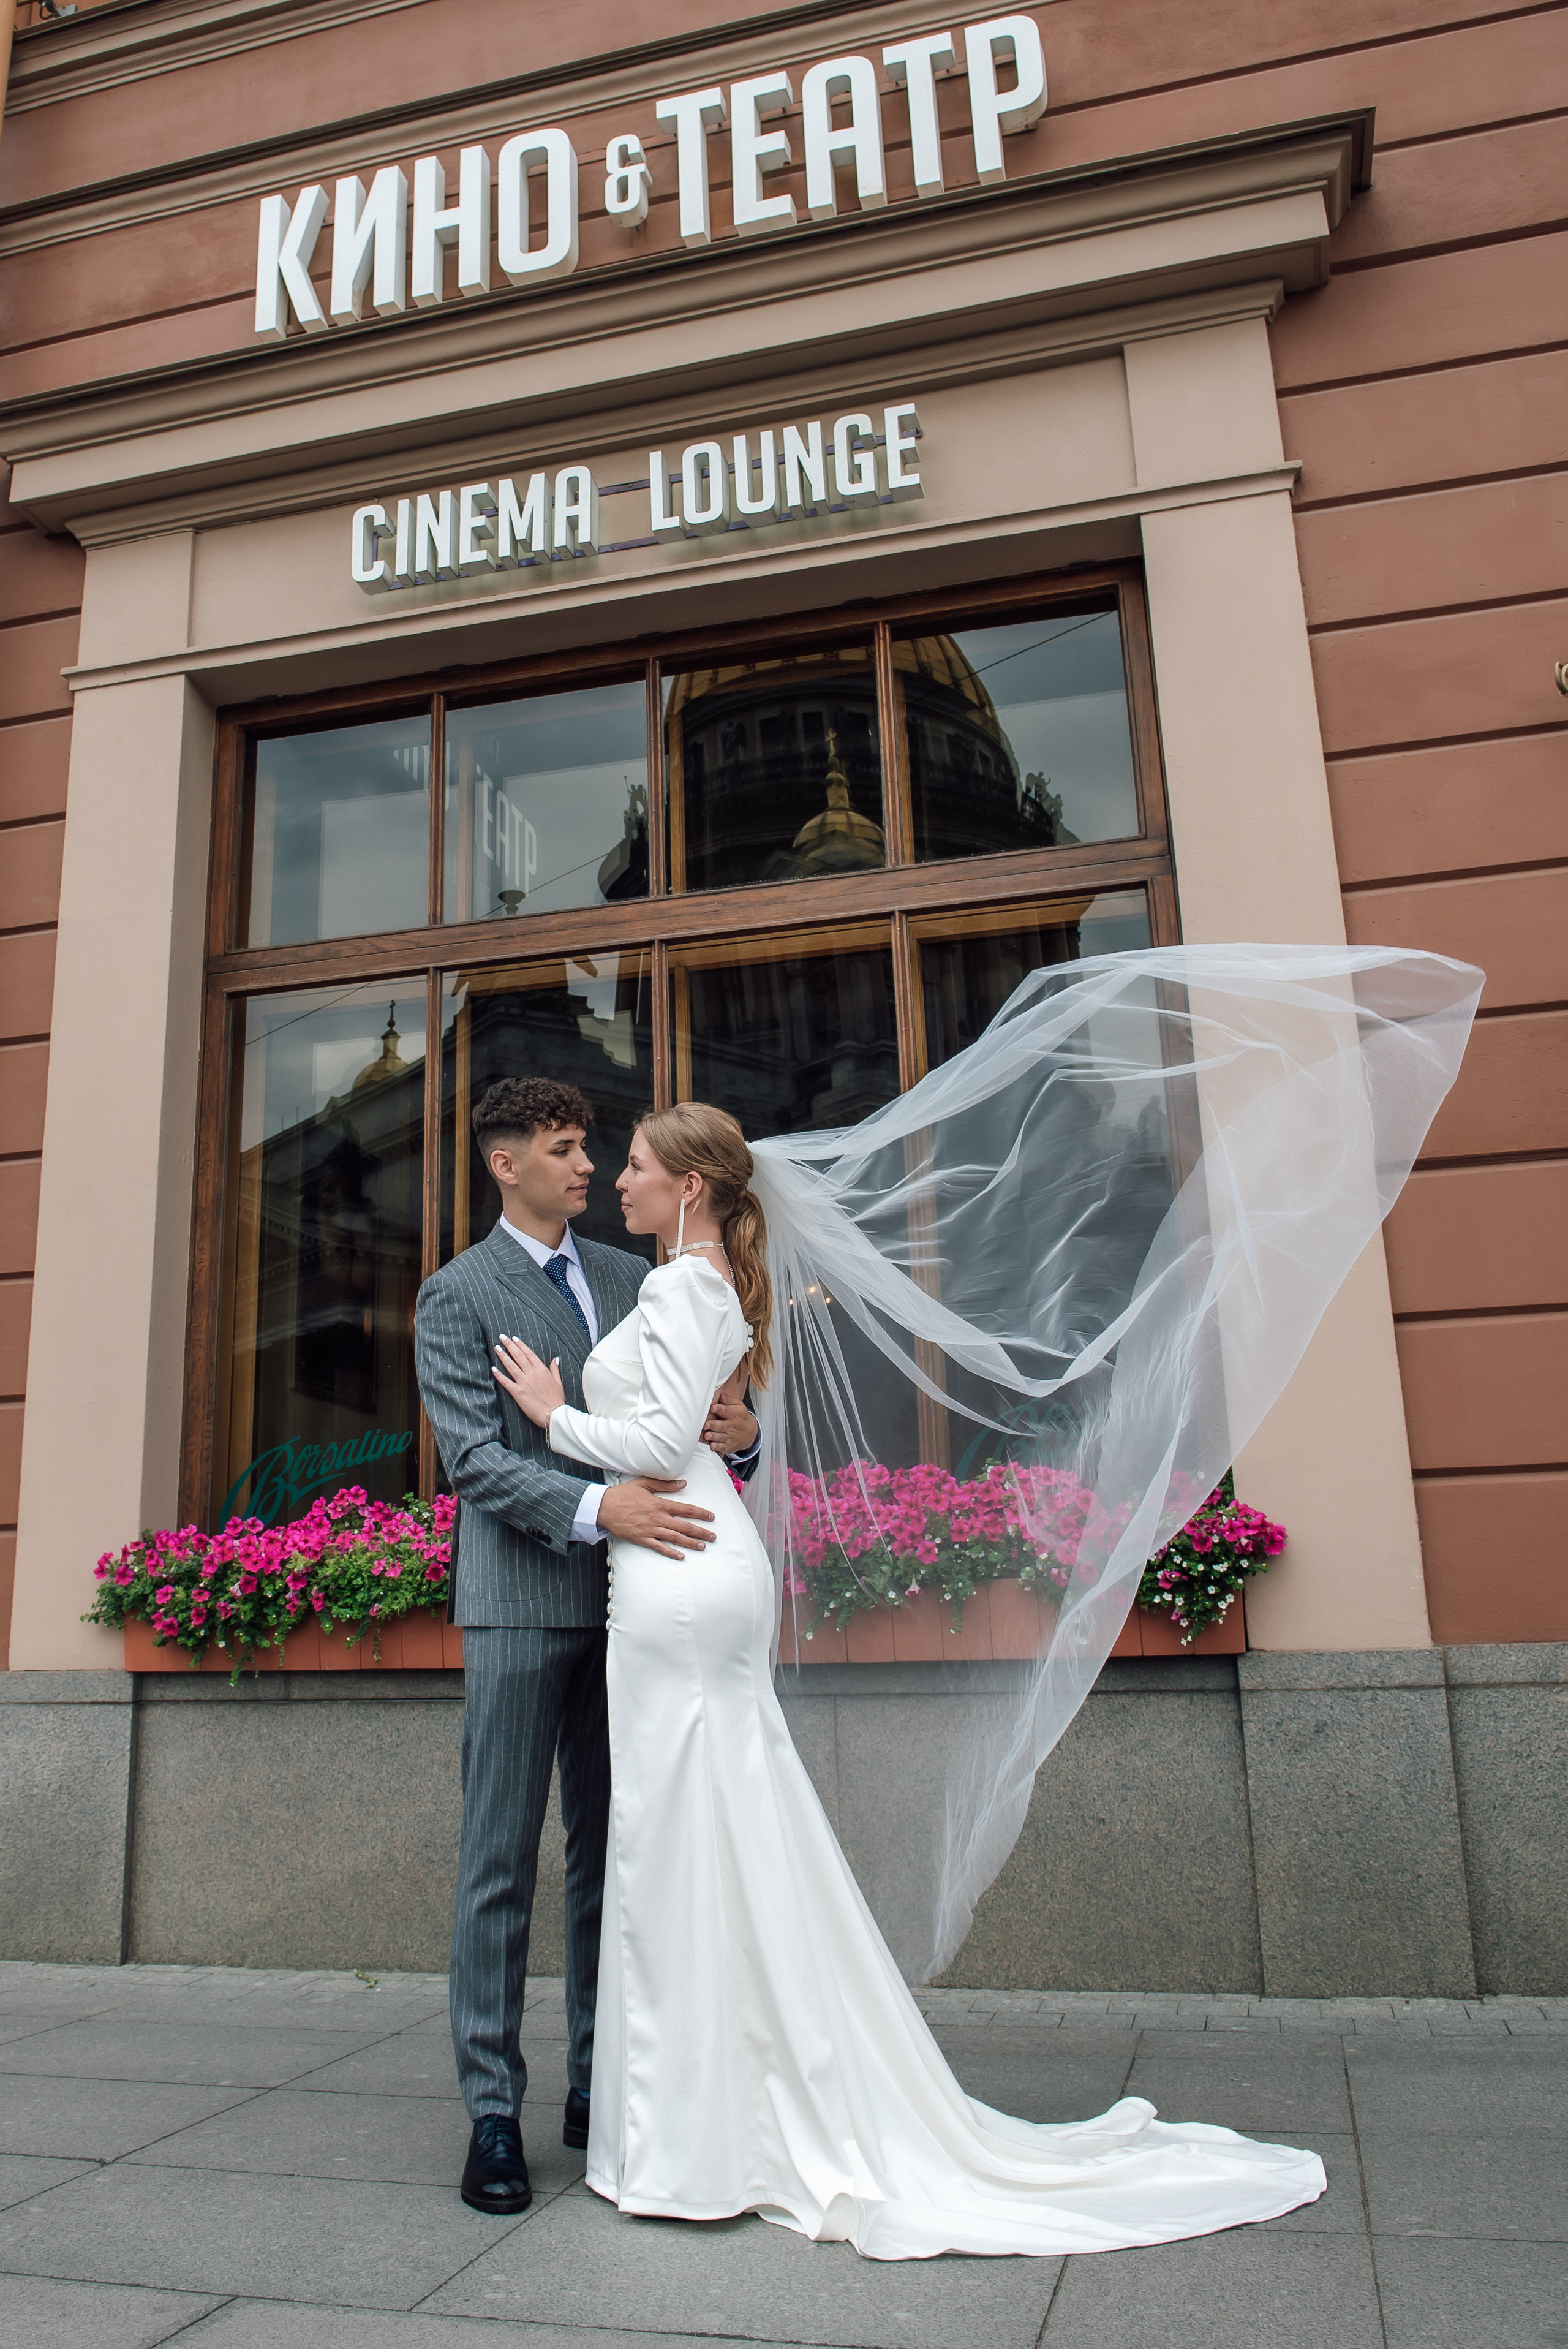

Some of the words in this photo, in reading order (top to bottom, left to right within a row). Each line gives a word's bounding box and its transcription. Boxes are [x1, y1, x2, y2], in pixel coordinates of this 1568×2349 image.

[255, 127, 578, 339] КИНО
[604, 134, 652, 224] &
[655, 15, 1047, 246] ТЕАТР
[351, 466, 597, 592] CINEMA
[649, 403, 923, 539] LOUNGE
[475, 762, 538, 898] ЕАТР
[218, 1428, 413, 1534] Borsalino
